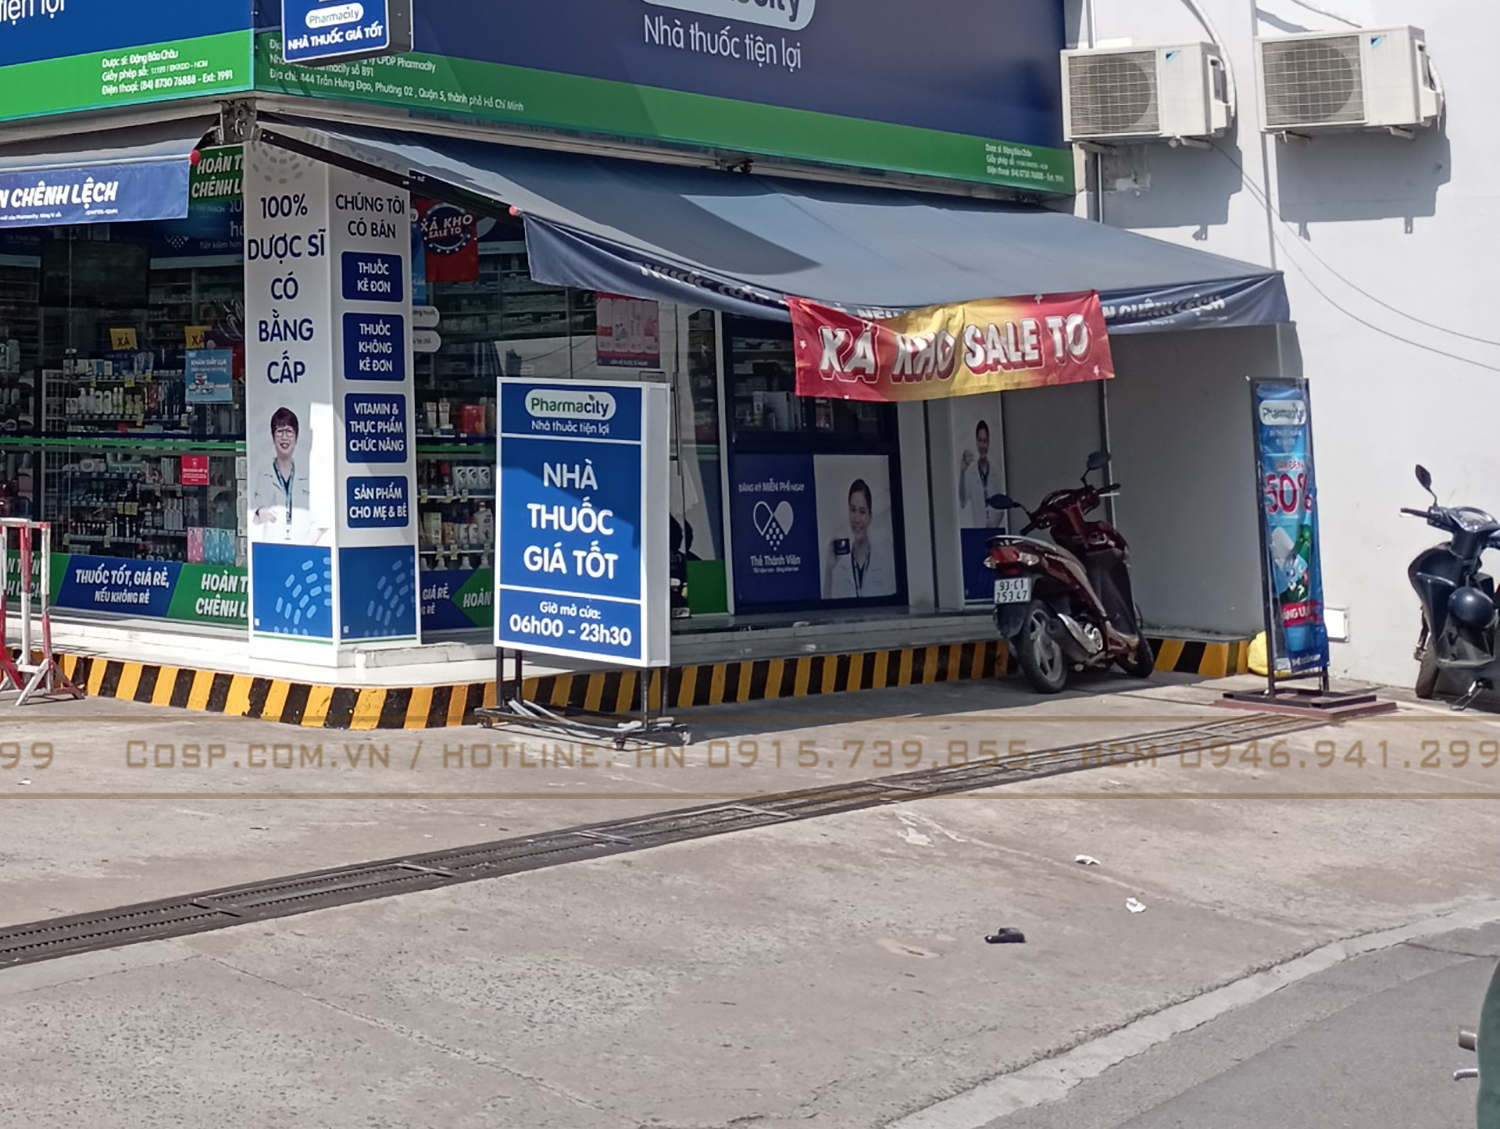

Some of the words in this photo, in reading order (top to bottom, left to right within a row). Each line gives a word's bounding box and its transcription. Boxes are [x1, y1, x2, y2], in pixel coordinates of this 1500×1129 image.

[288, 35, 309, 51] NHÀ
[310, 27, 344, 46] THUỐC
[643, 14, 684, 50] Nhà
[689, 24, 740, 61] thuốc
[744, 34, 777, 68] tiện
[782, 40, 802, 72] lợi
[10, 182, 70, 208] CHÊNH
[72, 177, 118, 208] LỆCH
[260, 193, 308, 219] 100%
[335, 192, 383, 212] CHÚNG
[387, 195, 405, 214] TÔI
[348, 217, 367, 237] CÓ
[371, 219, 396, 238] BÁN
[248, 233, 302, 264] DƯỢC
[307, 228, 326, 257] SĨ
[357, 258, 389, 275] THUỐC
[271, 272, 299, 300] CÓ
[357, 278, 369, 292] KÊ
[370, 280, 391, 293] ĐƠN
[259, 309, 314, 342] BẰNG
[963, 318, 1044, 374] SALE
[267, 350, 306, 384] CẤP
[531, 394, 609, 417] Pharmacity
[531, 419, 550, 431] Nhà
[552, 420, 577, 434] thuốc
[581, 421, 597, 435] tiện
[543, 458, 598, 490] NHÀ
[527, 496, 613, 535] THUỐC
[523, 542, 566, 575] GIÁ
[572, 540, 618, 579] TỐT
[75, 562, 109, 584] THUỐC
[133, 566, 151, 587] GIÁ
[539, 600, 557, 614] Giờ
[559, 604, 577, 617] mở
[580, 605, 601, 620] cửa:
[509, 614, 563, 638] 06h00
[580, 623, 632, 646] 23h30
